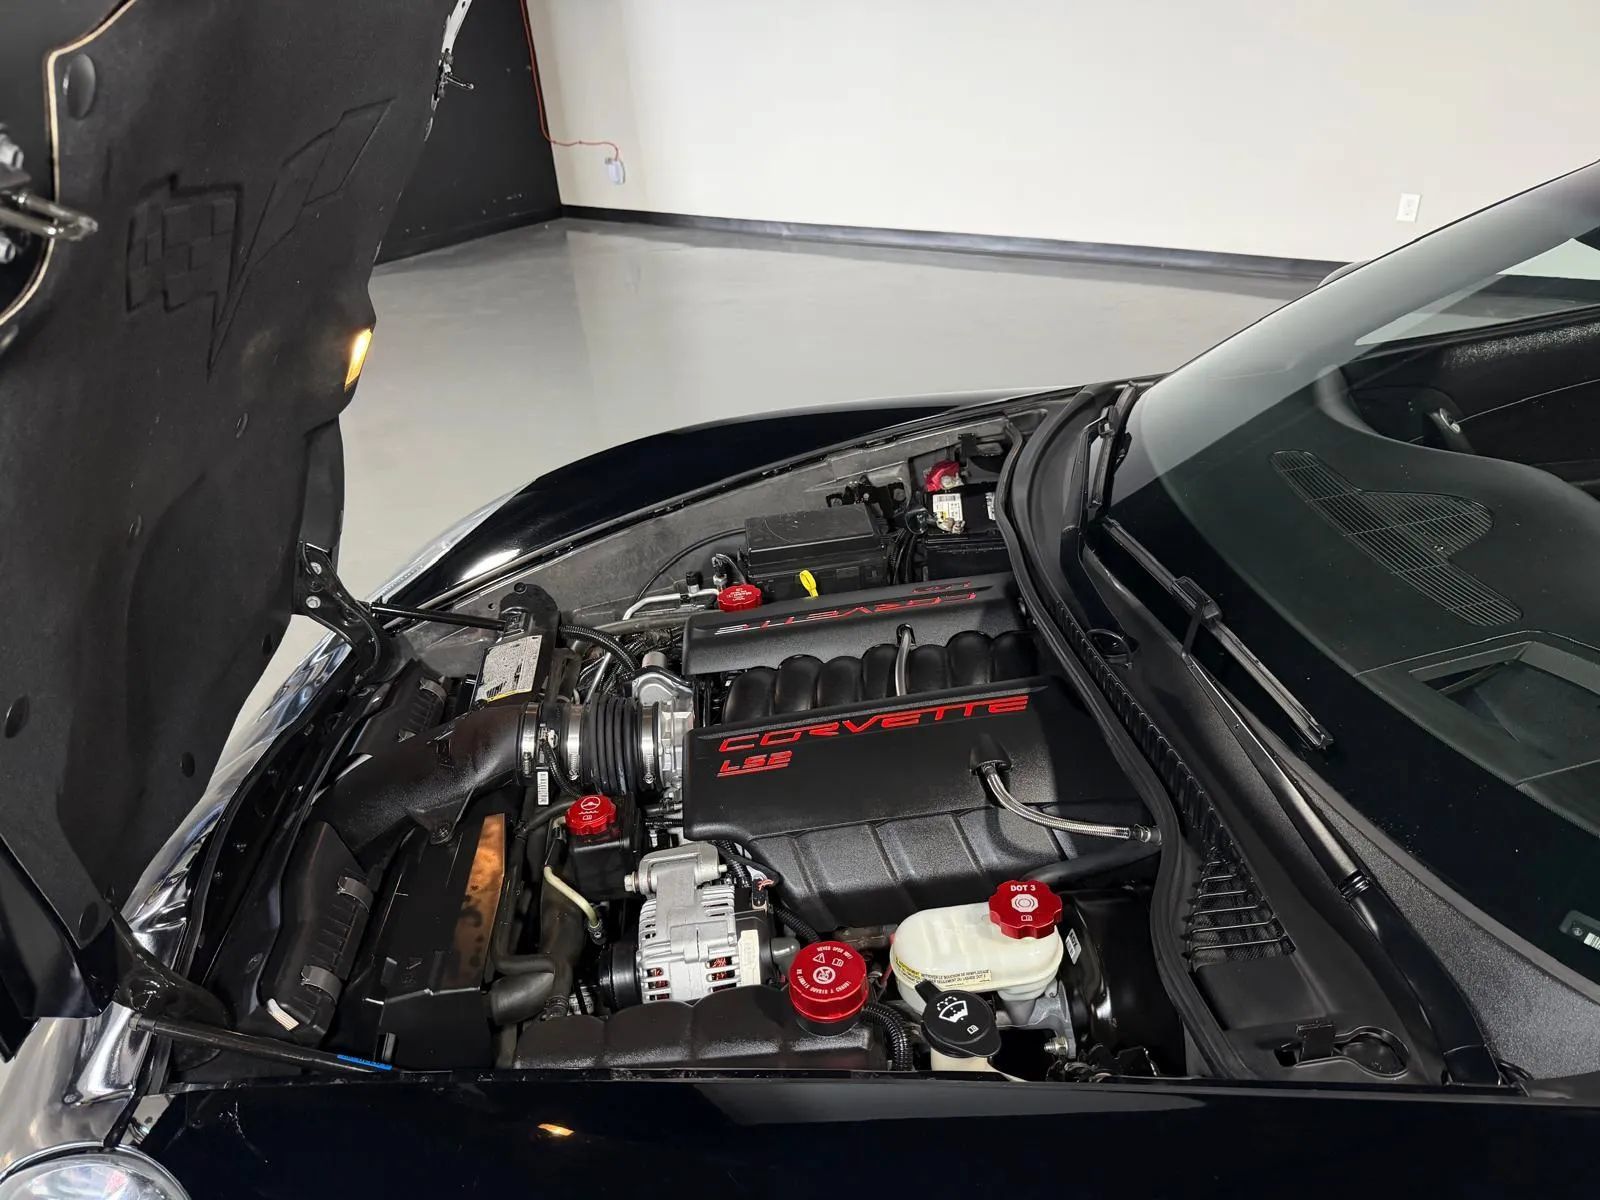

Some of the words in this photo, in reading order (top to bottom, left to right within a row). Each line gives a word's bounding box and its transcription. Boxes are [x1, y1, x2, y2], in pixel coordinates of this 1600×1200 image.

[714, 592, 977, 635] CORVETTE
[718, 695, 1029, 752] CORVETTE
[718, 750, 793, 775] LS2
[1010, 884, 1028, 892] DOT
[1030, 884, 1036, 892] 3
[832, 946, 844, 954] OPEN
